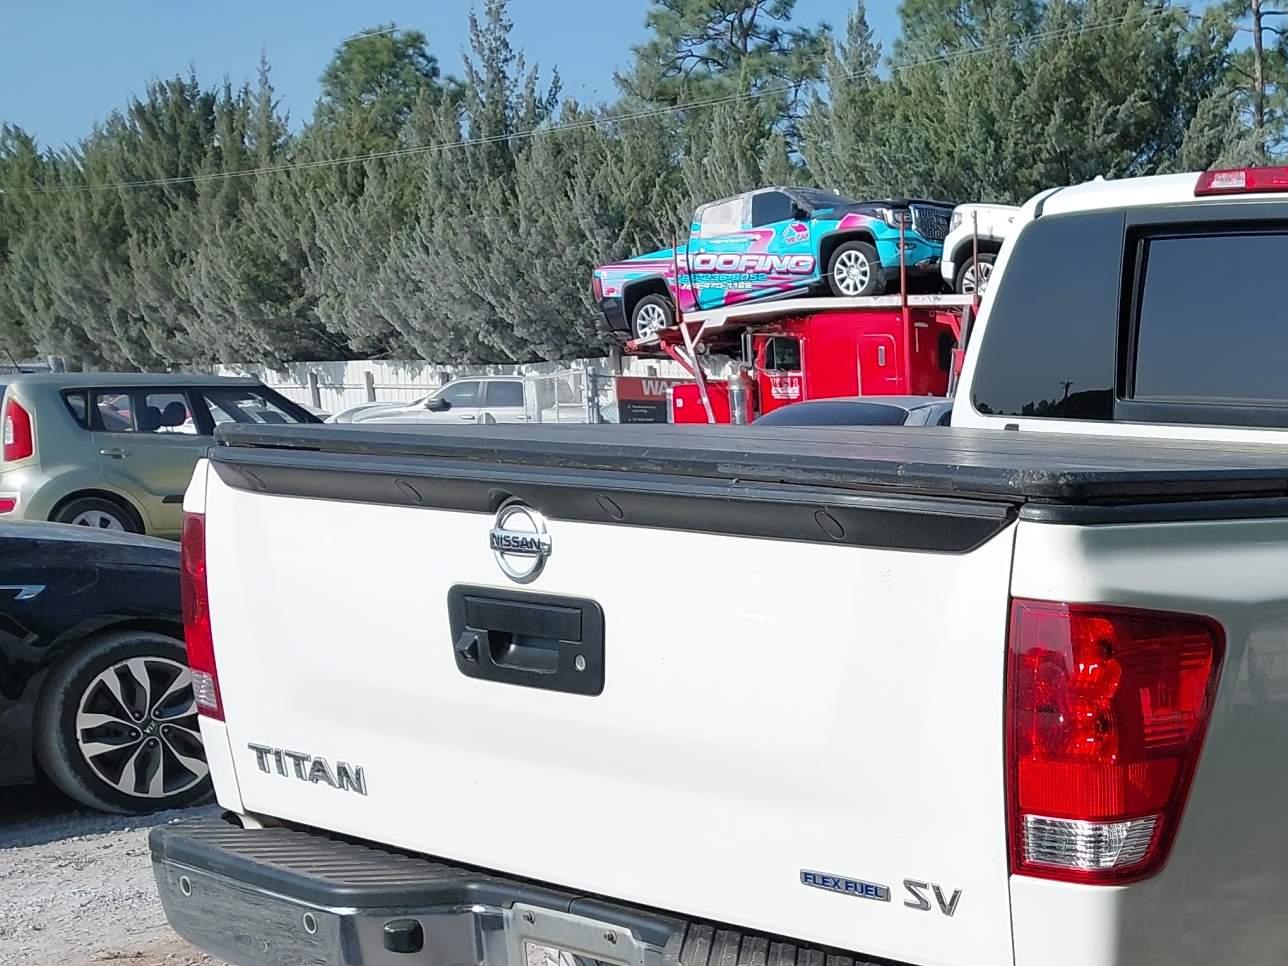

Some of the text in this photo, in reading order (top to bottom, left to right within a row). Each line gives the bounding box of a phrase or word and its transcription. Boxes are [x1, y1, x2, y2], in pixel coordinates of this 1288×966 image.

[490, 531, 543, 551] NISSAN
[248, 743, 368, 796] TITAN
[803, 872, 884, 899] FLEX FUEL
[902, 877, 963, 918] SV
